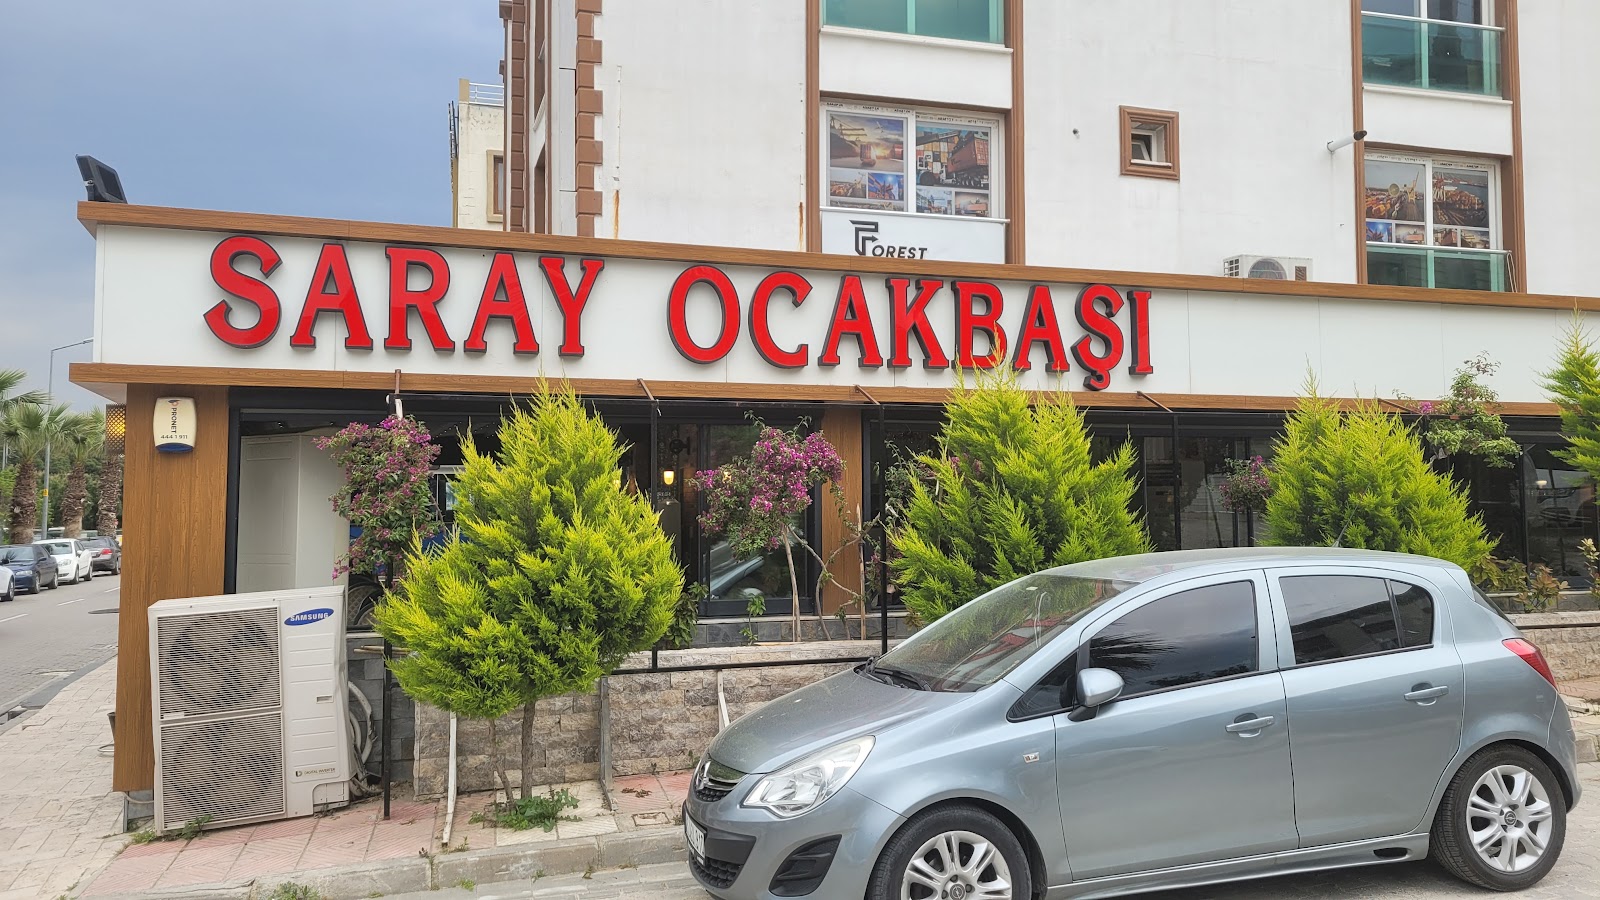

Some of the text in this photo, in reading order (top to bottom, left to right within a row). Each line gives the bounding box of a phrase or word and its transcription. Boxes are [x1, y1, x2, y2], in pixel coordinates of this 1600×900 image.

[203, 235, 1154, 391] SARAY OCAKBAŞI
[290, 612, 329, 622] SAMSUNG
